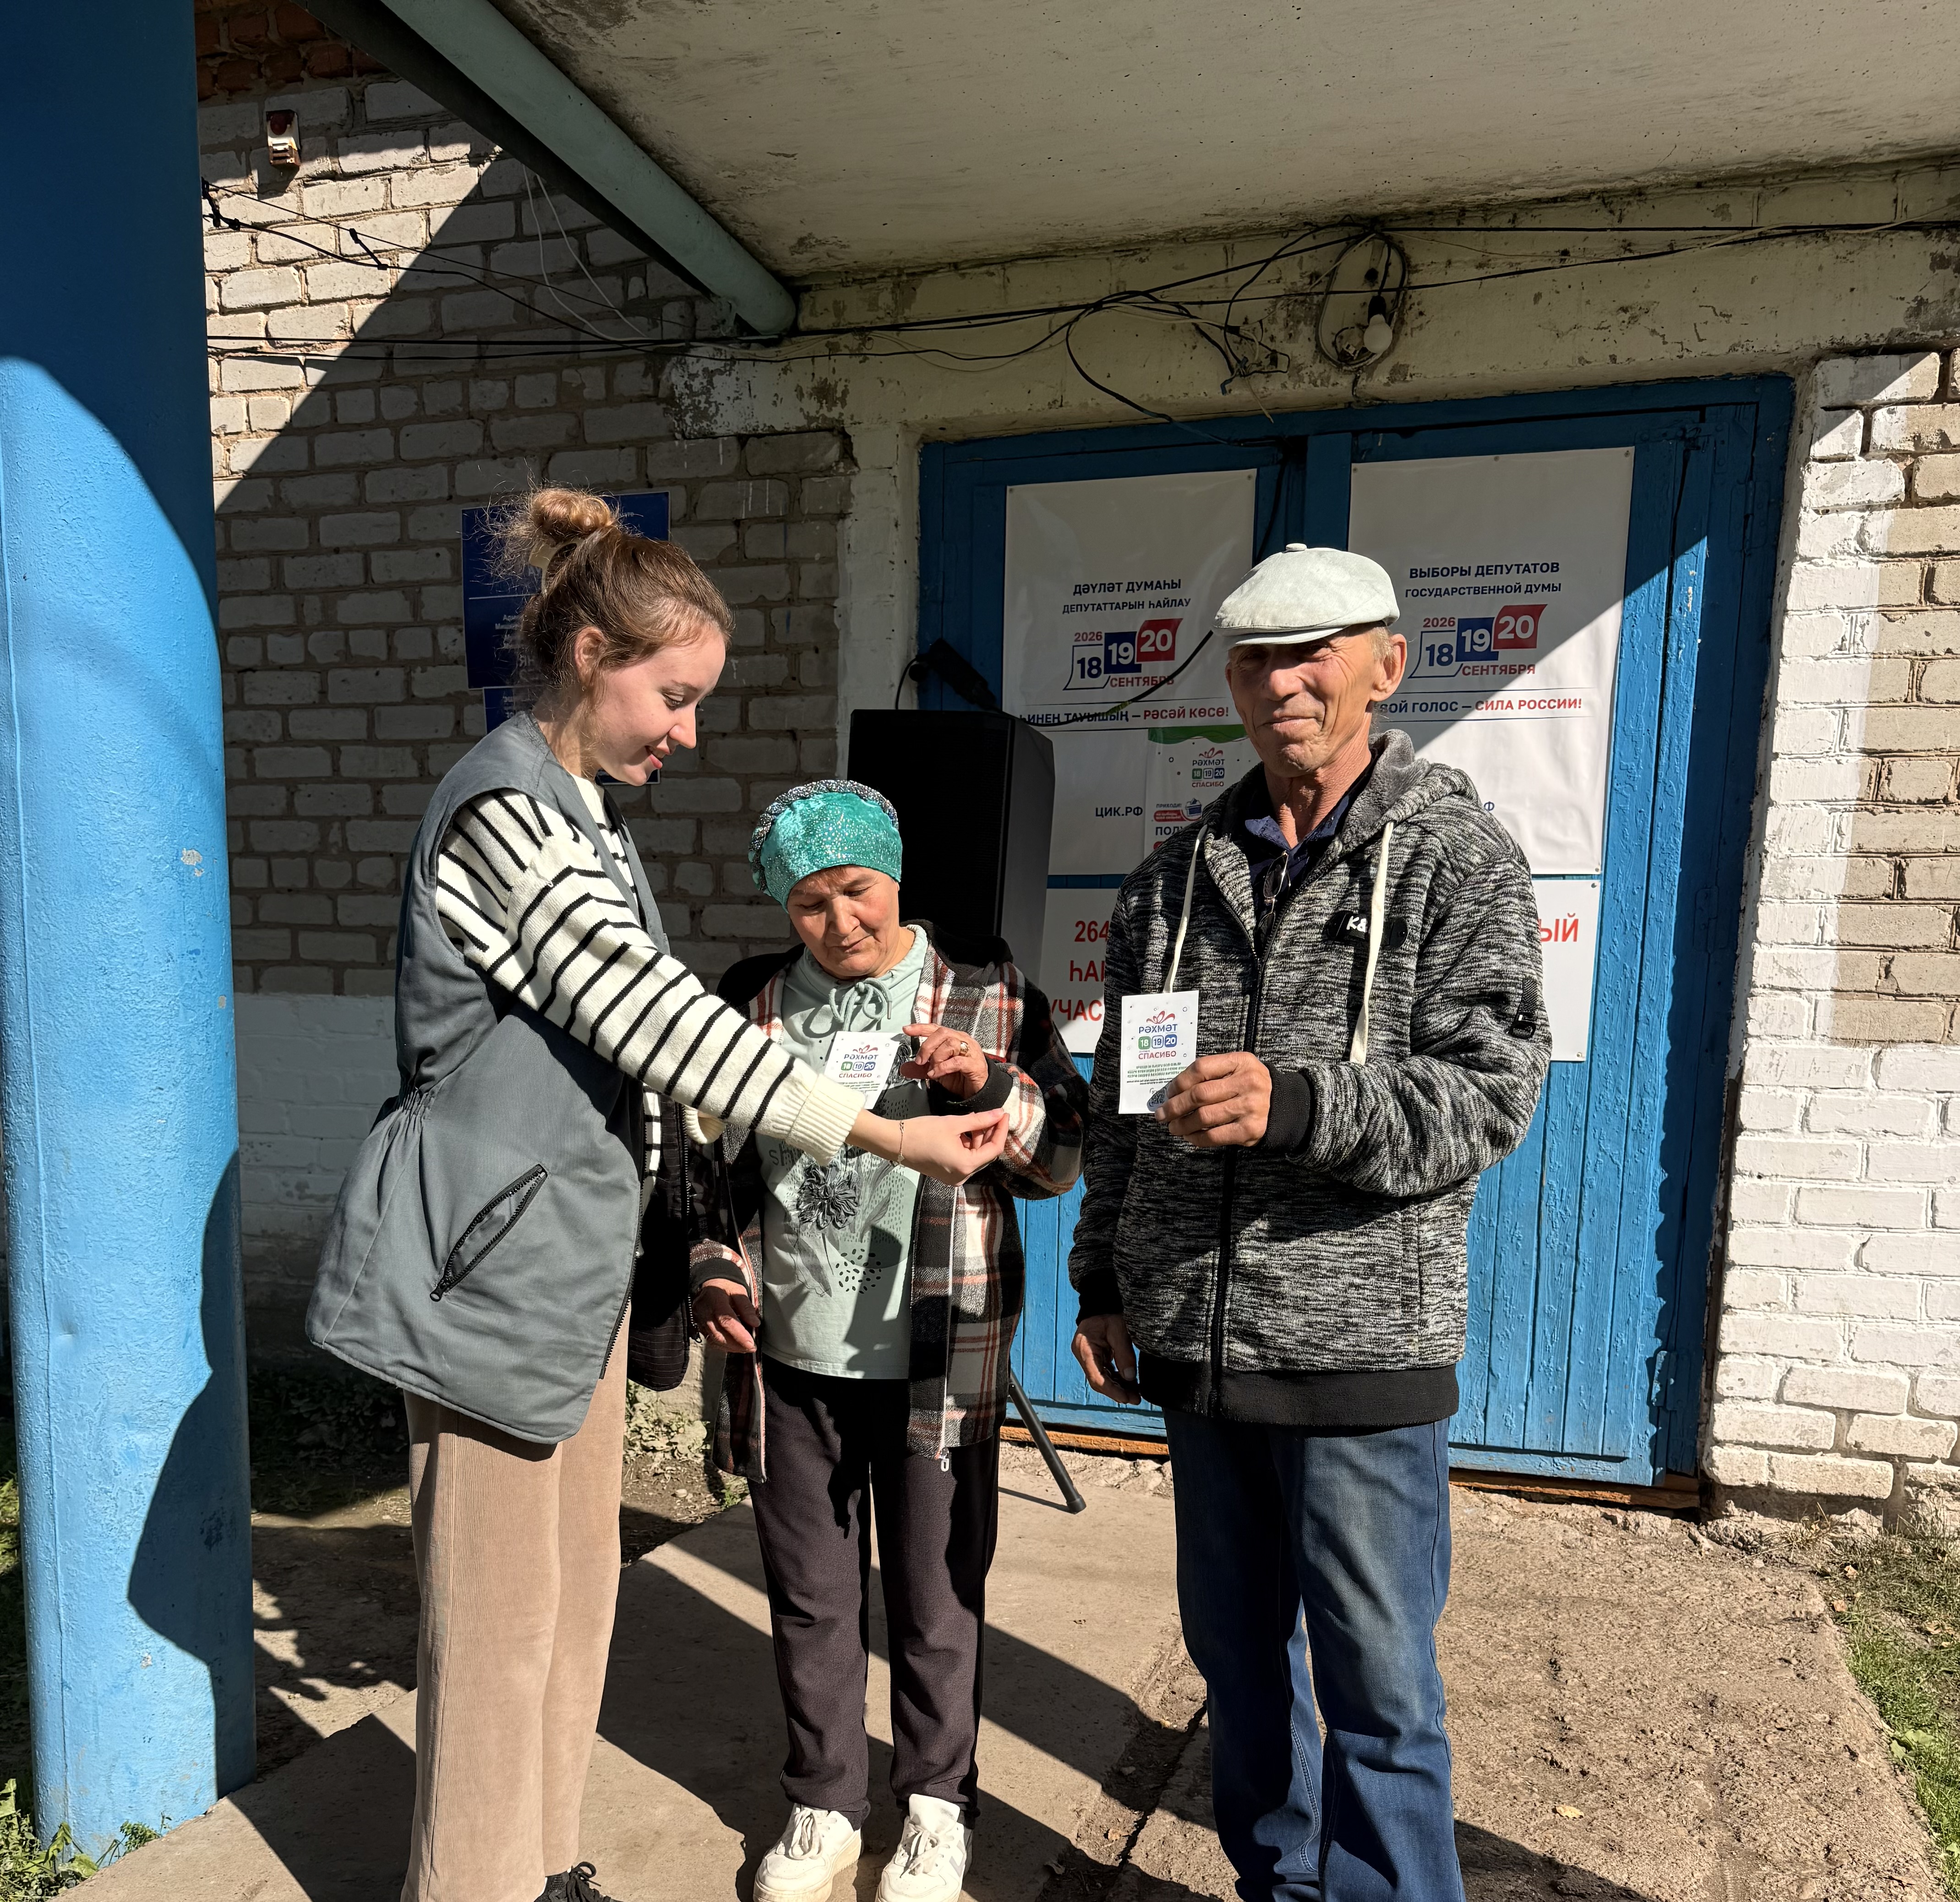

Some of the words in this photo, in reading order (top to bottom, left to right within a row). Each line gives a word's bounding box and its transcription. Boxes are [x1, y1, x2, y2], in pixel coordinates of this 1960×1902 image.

[1409, 565, 1471, 579] ВЫБОРЫ
[1474, 562, 1560, 578] ДЕПУТАТОВ
[1073, 582, 1124, 596] ДӘҮЛӘТ
[1126, 579, 1182, 593] ДУМАҺЫ
[1405, 583, 1522, 598] ГОСУДАРСТВЕННОЙ
[1524, 583, 1561, 595] ДУМЫ
[1062, 601, 1145, 614] ДЕПУТАТТАРЫН
[1148, 597, 1191, 609] ҺАЙЛАУ
[1423, 617, 1456, 628] 2026
[1497, 614, 1535, 639] 20
[1074, 631, 1103, 642] 2026
[1140, 629, 1173, 652] 20
[1461, 629, 1491, 652] 19
[1108, 642, 1135, 665] 19
[1425, 644, 1454, 667] 18
[1076, 656, 1103, 679] 18
[1462, 664, 1536, 677] СЕНТЯБРЯ
[1377, 700, 1408, 713] ВОЙ
[1412, 701, 1458, 713] ГОЛОС
[1475, 700, 1513, 711] СИЛА
[1518, 698, 1582, 710] РОССИИ!
[1143, 707, 1186, 721] РӘСӘЙ
[1189, 706, 1229, 719] КӨСӨ!
[1095, 806, 1144, 818] ЦИК.РФ
[1155, 826, 1183, 836] ПОЛ
[1139, 1024, 1178, 1034] РӘХМӘТ
[1140, 1038, 1149, 1047] 18
[1153, 1038, 1162, 1046] 19
[1165, 1036, 1176, 1045] 20
[1138, 1051, 1177, 1060] СПАСИБО
